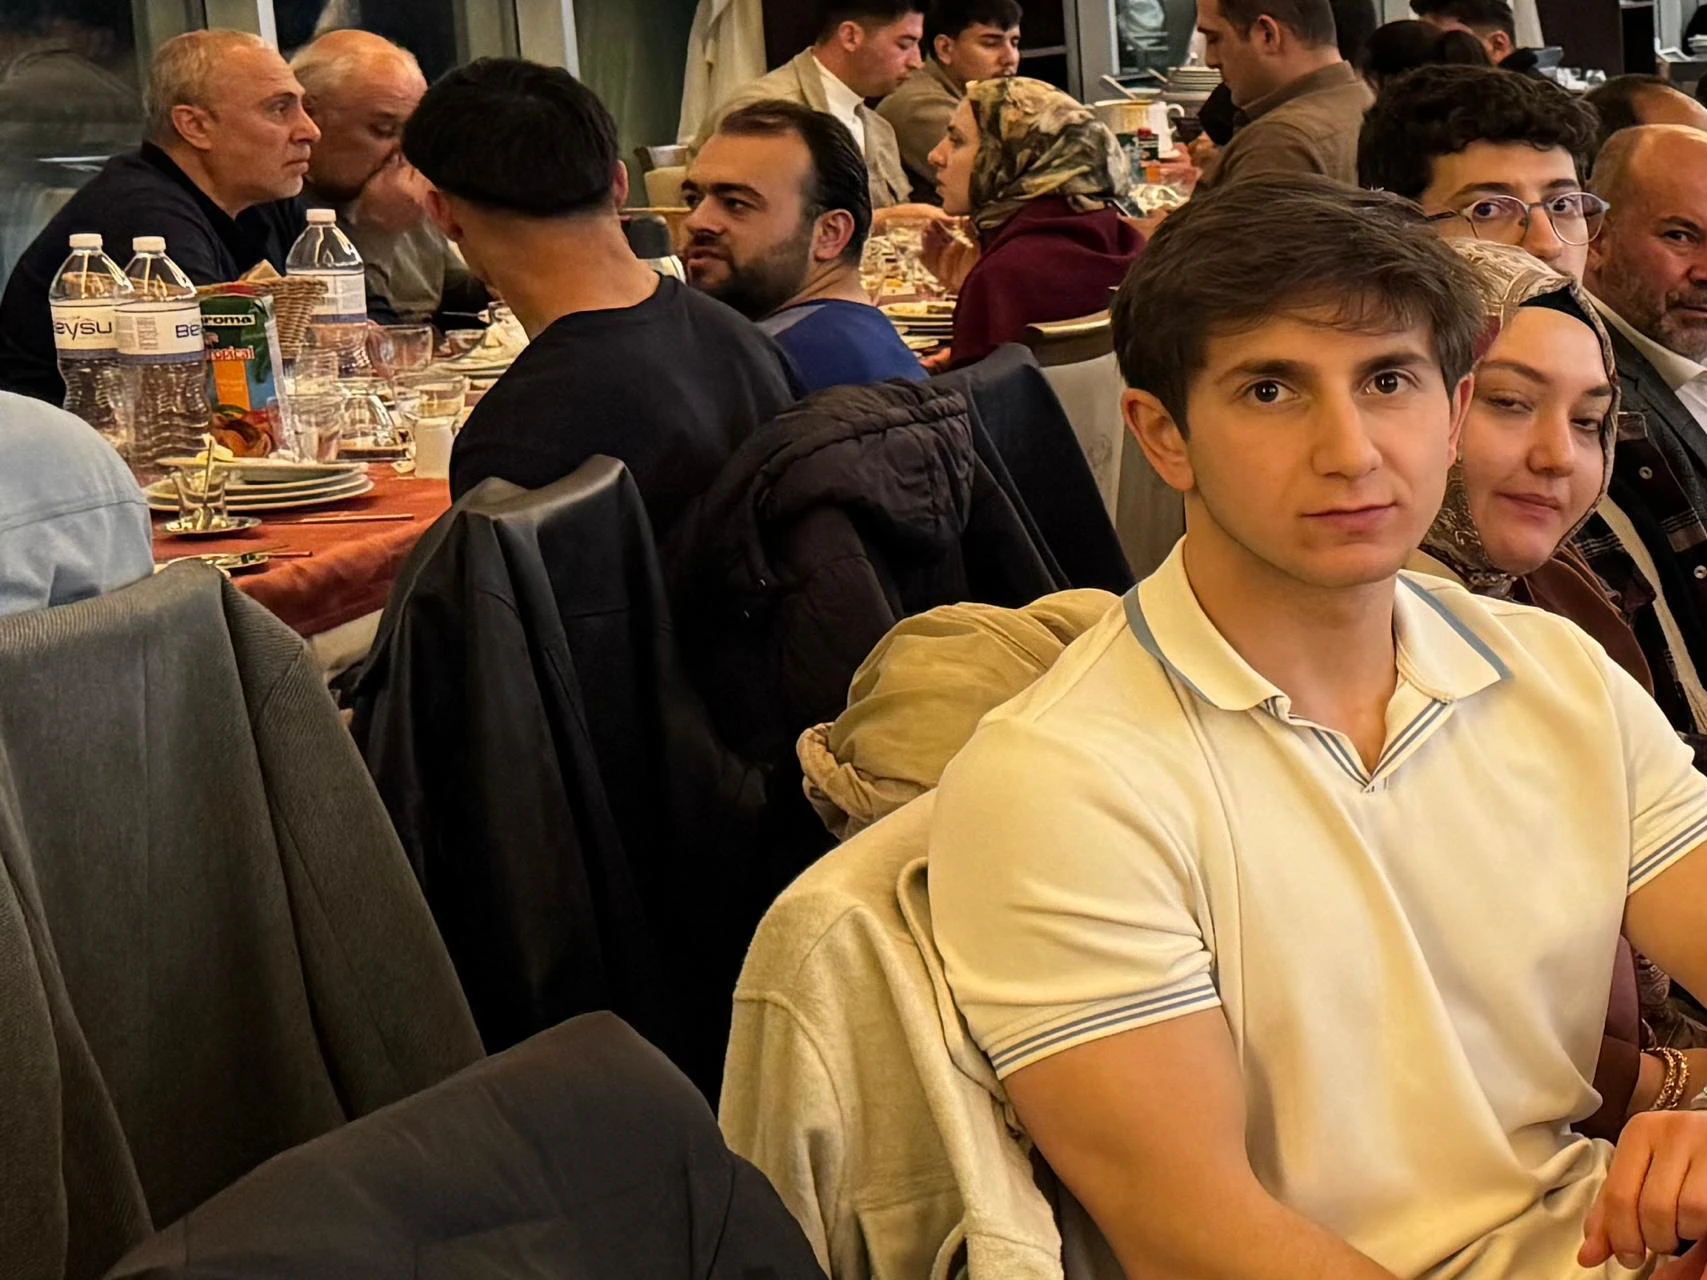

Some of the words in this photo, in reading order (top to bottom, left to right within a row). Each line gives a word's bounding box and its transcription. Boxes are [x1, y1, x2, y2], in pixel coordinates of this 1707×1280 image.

[201, 316, 252, 325] roma
[55, 321, 112, 340] eysu
[208, 345, 255, 360] ropical
